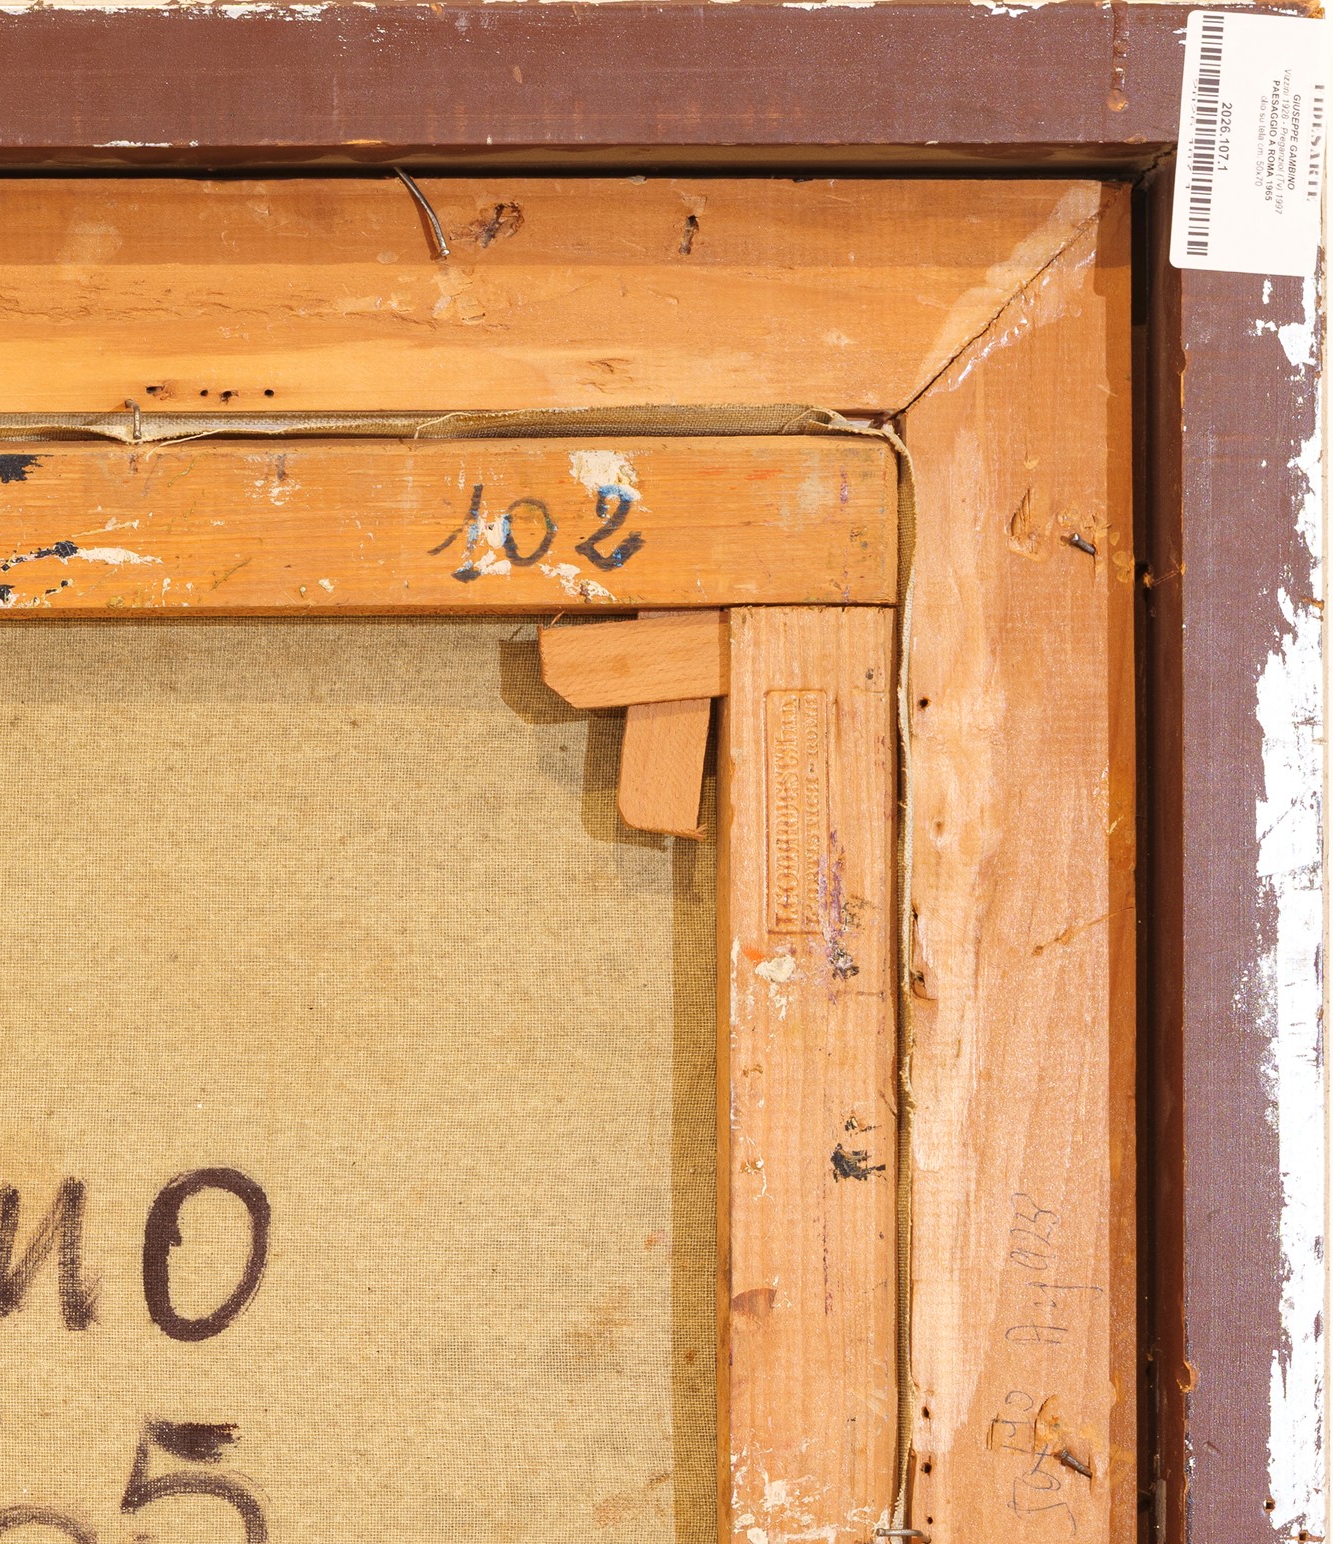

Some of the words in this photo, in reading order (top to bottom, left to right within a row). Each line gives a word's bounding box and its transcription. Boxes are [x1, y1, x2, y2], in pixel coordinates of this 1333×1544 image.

[1268, 80, 1281, 137] PAESAGGIO
[1280, 99, 1290, 119] 1928
[1289, 94, 1301, 143] GIUSEPPE
[1217, 102, 1233, 172] 2026.107.1
[1266, 148, 1277, 177] ROMA
[1287, 145, 1298, 190] GAMBINO
[1264, 180, 1274, 201] 1965
[1273, 193, 1284, 215] 1997
